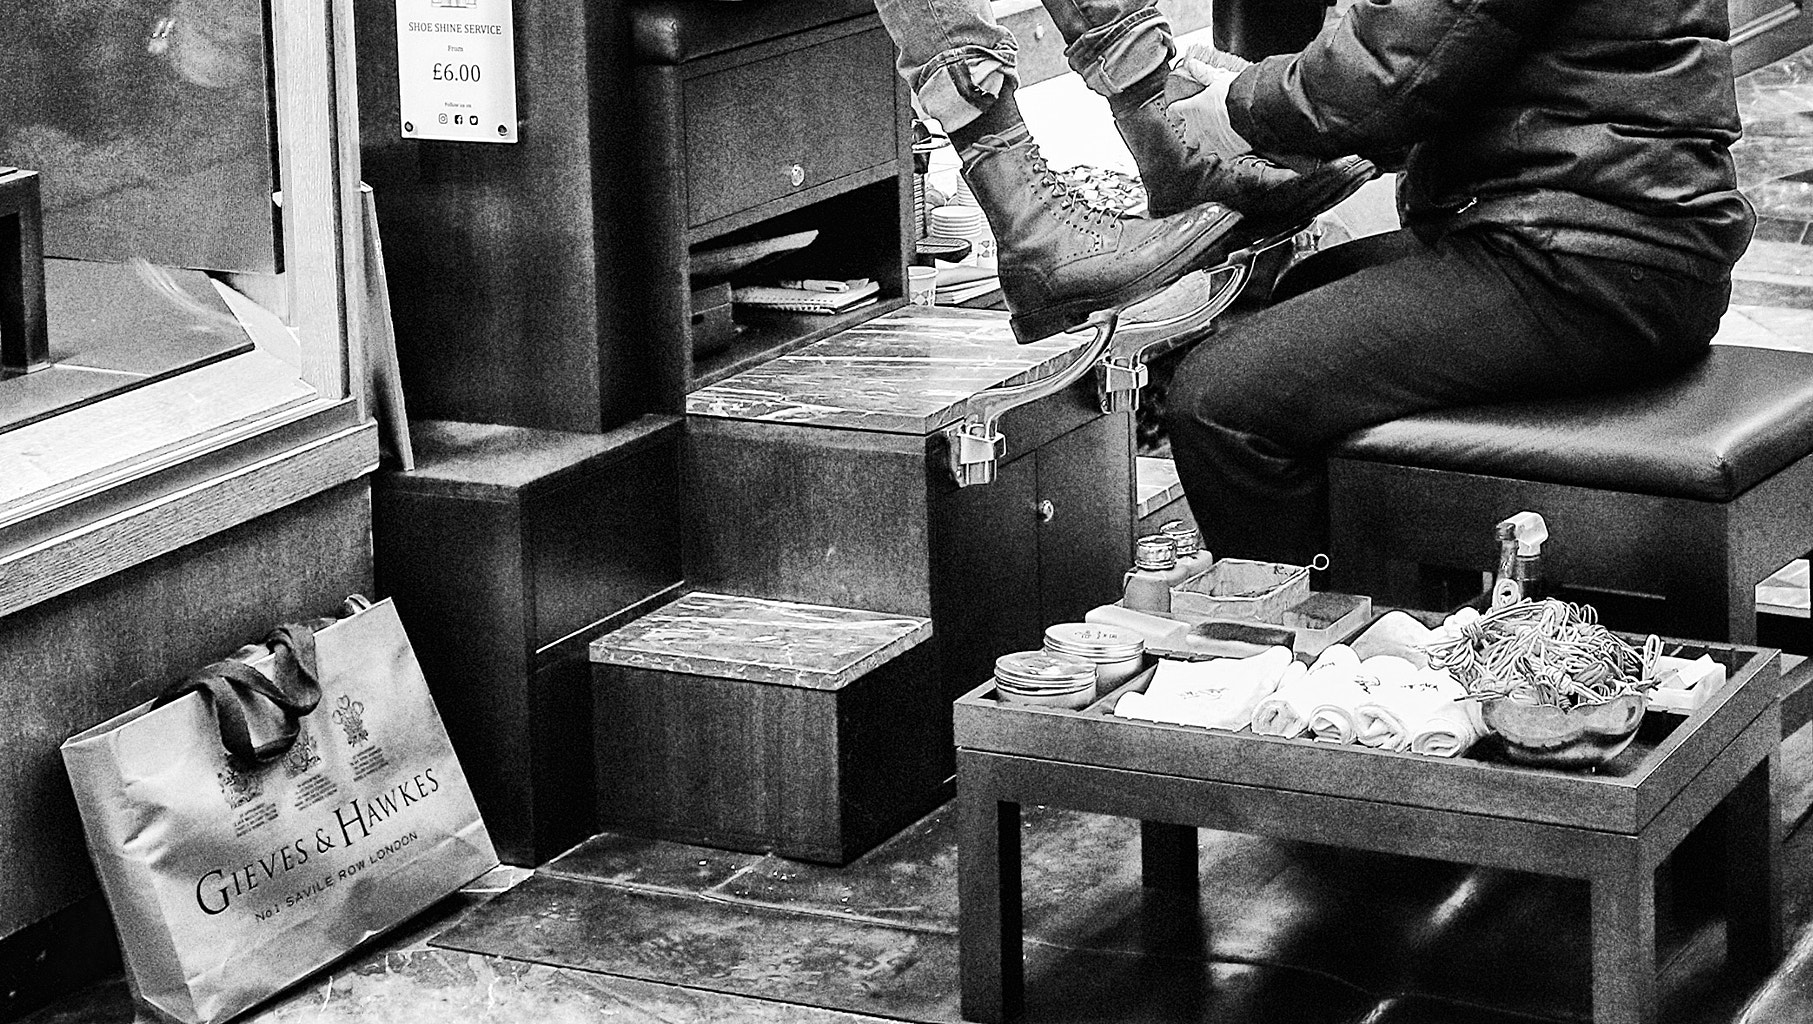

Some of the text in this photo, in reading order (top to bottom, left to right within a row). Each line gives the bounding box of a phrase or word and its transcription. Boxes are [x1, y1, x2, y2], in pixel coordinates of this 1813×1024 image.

[408, 21, 502, 35] SHOE SHINE SERVICE
[433, 62, 481, 82] £6.00
[196, 838, 308, 915] GIEVES
[315, 828, 336, 854] &
[332, 768, 439, 848] HAWKES
[285, 875, 335, 908] SAVILE
[338, 860, 365, 881] ROW
[369, 831, 418, 864] LONDON
